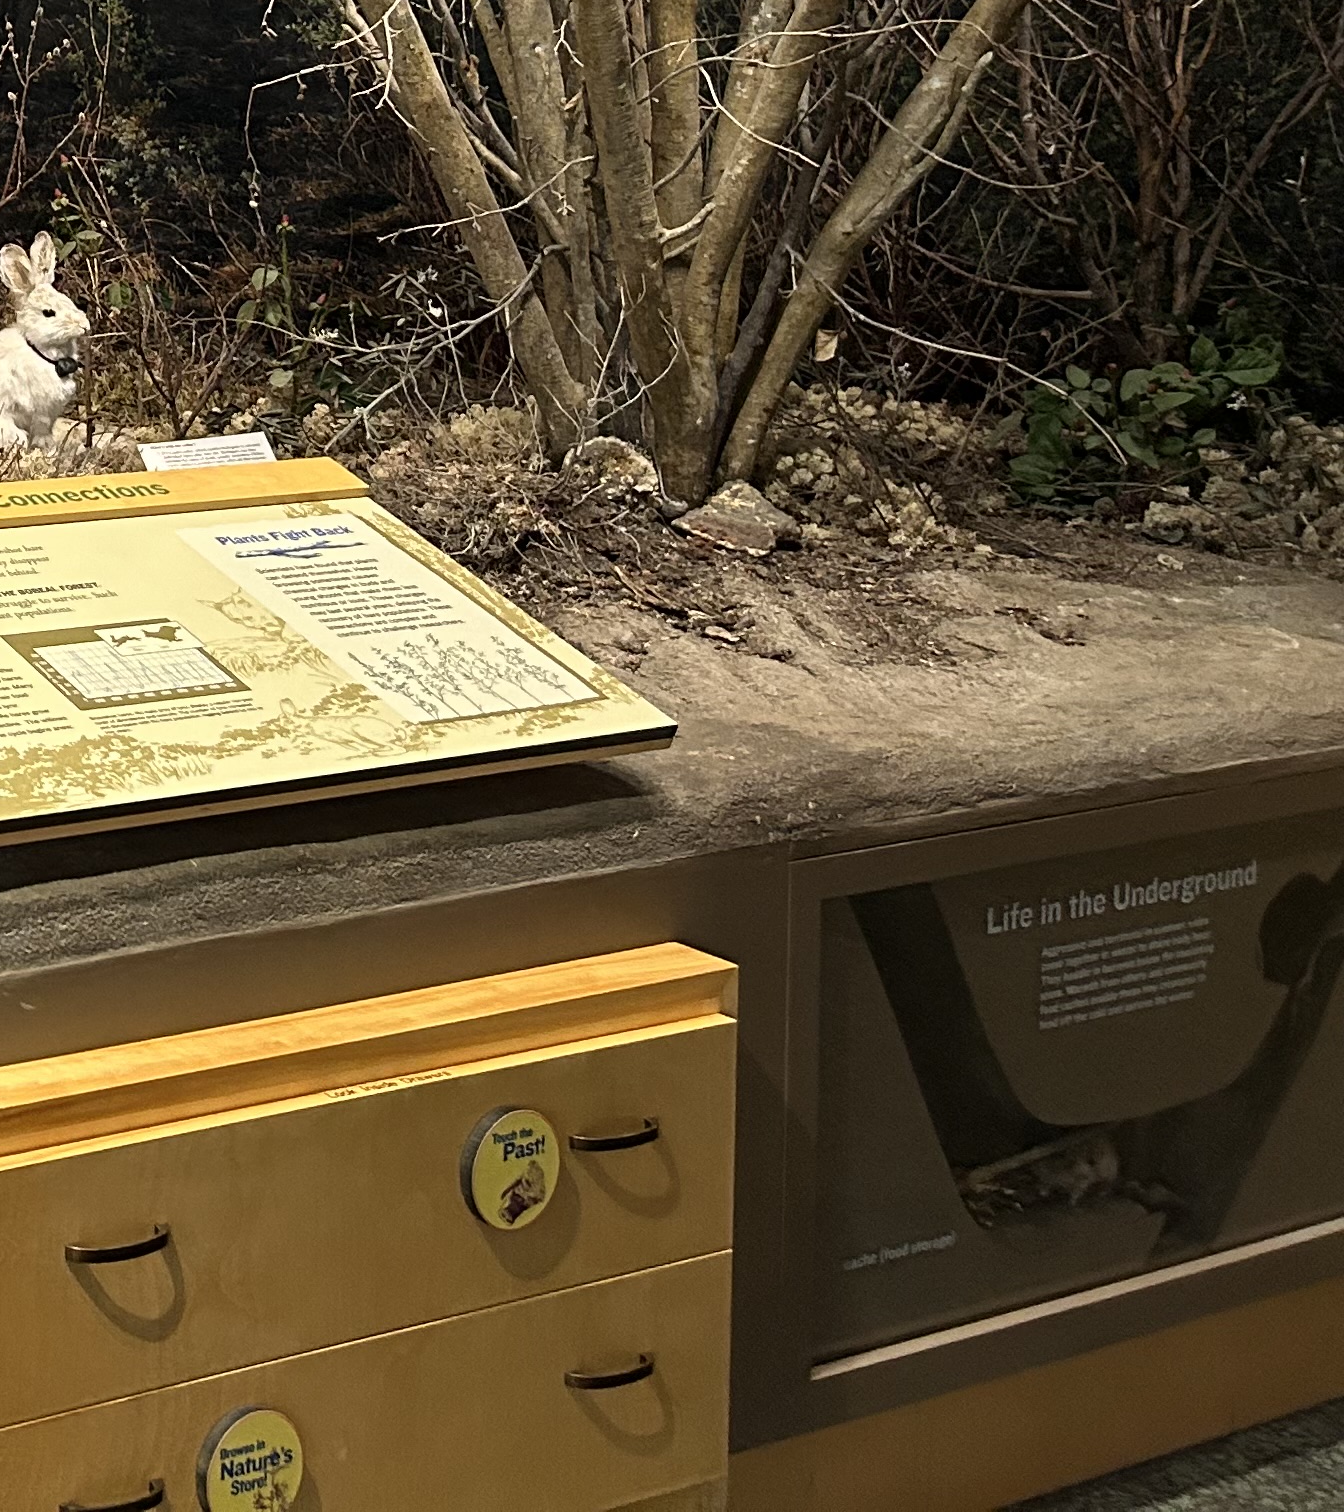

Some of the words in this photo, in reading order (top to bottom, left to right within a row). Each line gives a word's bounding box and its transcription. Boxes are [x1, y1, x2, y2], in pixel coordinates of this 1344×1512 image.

[216, 534, 270, 545] Plants
[268, 530, 312, 540] Fight
[310, 525, 354, 536] Back
[17, 586, 59, 596] BOREAL
[986, 900, 1032, 934] Life
[1040, 897, 1062, 925] in
[1069, 889, 1106, 919] the
[1113, 859, 1257, 911] Underground
[492, 1130, 517, 1144] Touch
[519, 1128, 534, 1138] the
[503, 1134, 546, 1162] Past!
[220, 1443, 255, 1460] Browse
[256, 1439, 266, 1450] in
[220, 1446, 293, 1481] Nature's
